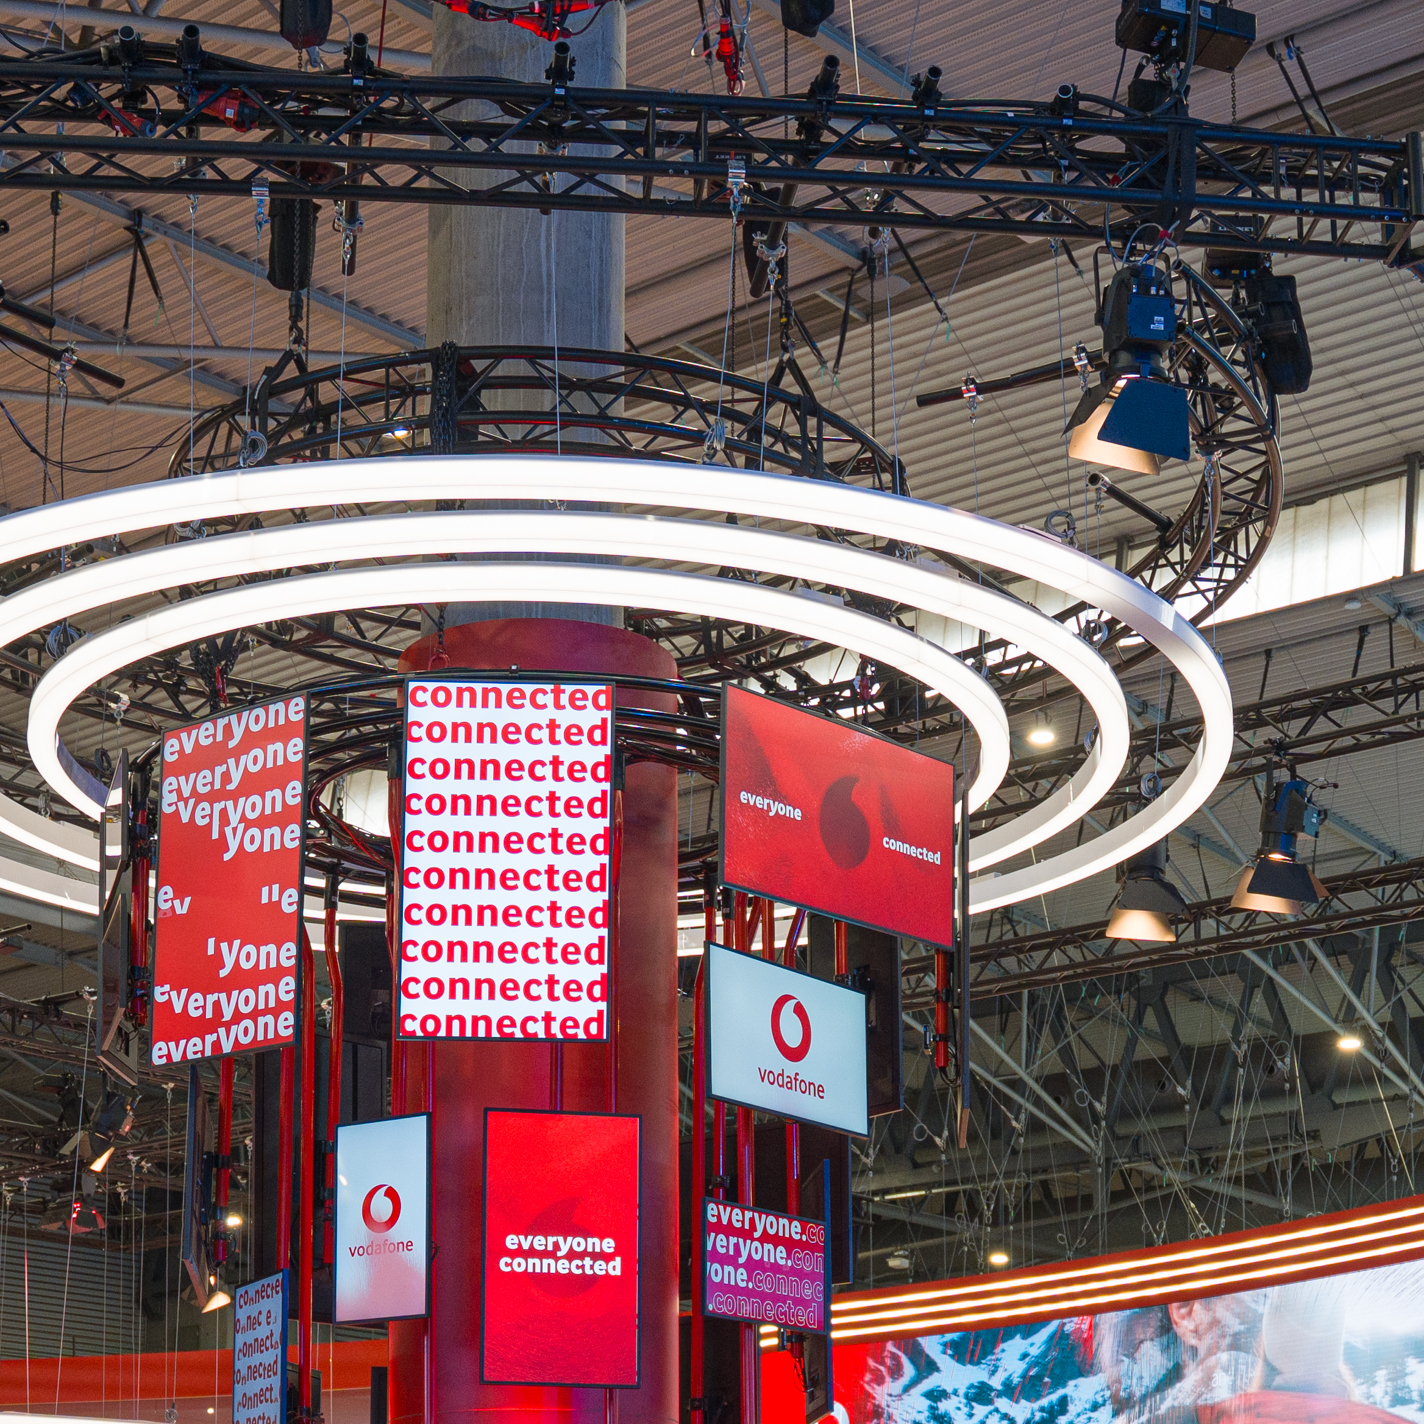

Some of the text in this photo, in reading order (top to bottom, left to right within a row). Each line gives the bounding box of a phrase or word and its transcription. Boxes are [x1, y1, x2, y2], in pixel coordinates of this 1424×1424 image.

[409, 684, 612, 711] connected
[163, 696, 305, 763] everyone
[406, 717, 608, 746] connected
[161, 737, 304, 799] everyone
[407, 754, 611, 783] connected
[405, 789, 608, 818] connected
[739, 790, 803, 821] everyone
[406, 826, 610, 855] connected
[882, 836, 941, 865] connected
[403, 863, 607, 892] connected
[404, 899, 608, 929] connected
[401, 935, 605, 965] connected
[401, 972, 608, 1002] connected
[400, 1009, 604, 1039] connected
[757, 1066, 825, 1100] vodafone
[348, 1238, 414, 1258] vodafone
[505, 1232, 616, 1257] everyone
[499, 1255, 622, 1276] connected
